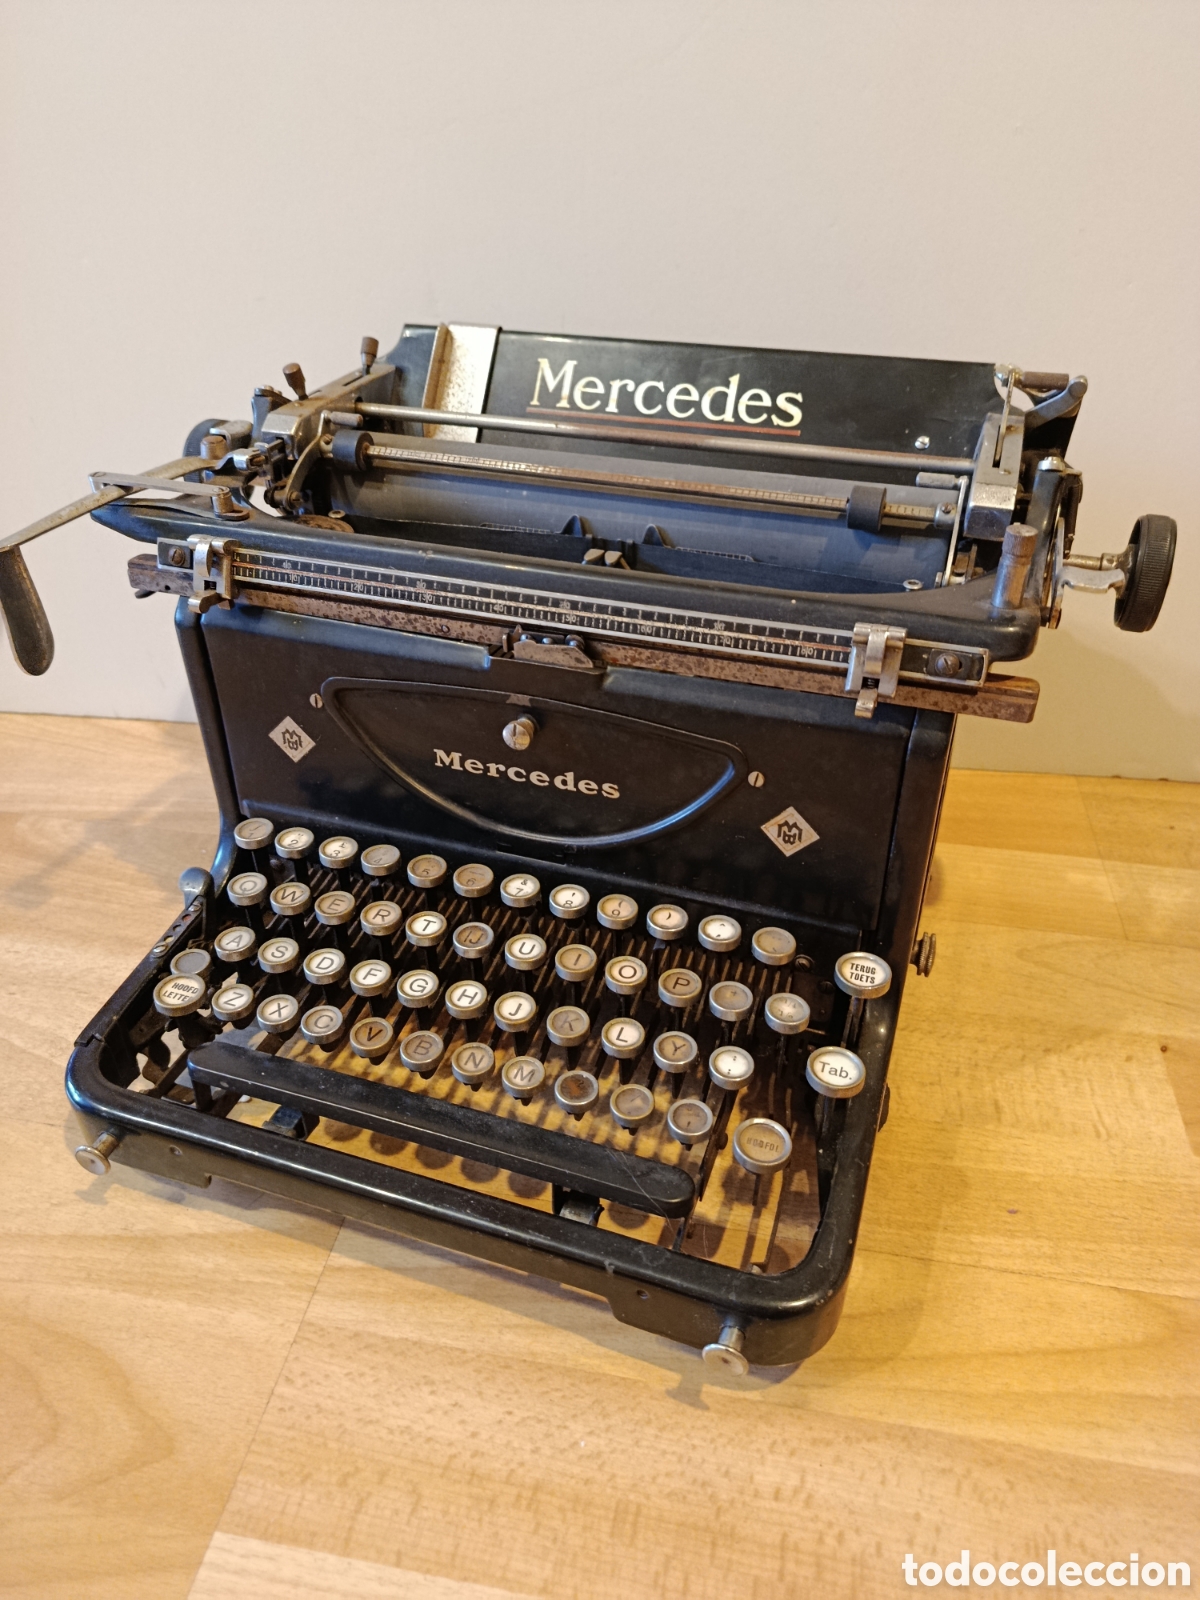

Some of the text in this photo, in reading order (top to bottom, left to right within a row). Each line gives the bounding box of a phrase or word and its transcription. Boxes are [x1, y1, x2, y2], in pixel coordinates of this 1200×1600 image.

[530, 358, 803, 428] Mercedes
[433, 748, 621, 799] Mercedes
[239, 880, 257, 895] Q
[280, 888, 300, 903] W
[327, 898, 345, 912] E
[372, 908, 391, 922] R
[422, 918, 437, 932] T
[225, 934, 243, 948] A
[518, 941, 536, 956] U
[270, 945, 288, 959] S
[315, 956, 335, 971] D
[850, 962, 877, 975] TERUG
[362, 967, 383, 981] F
[618, 964, 637, 979] O
[849, 971, 876, 985] TOETS
[171, 982, 199, 995] HOOFD
[408, 978, 429, 994] G
[672, 976, 691, 990] P
[162, 990, 195, 1002] LETTE
[223, 991, 245, 1007] Z
[456, 988, 479, 1005] H
[268, 1002, 289, 1018] X
[508, 1003, 522, 1017] J
[314, 1014, 334, 1030] C
[366, 1026, 384, 1042] V
[615, 1026, 629, 1043] L
[414, 1039, 433, 1056] B
[671, 1040, 686, 1056] Y
[463, 1052, 485, 1069] N
[513, 1065, 536, 1083] M
[819, 1061, 852, 1081] Tab.
